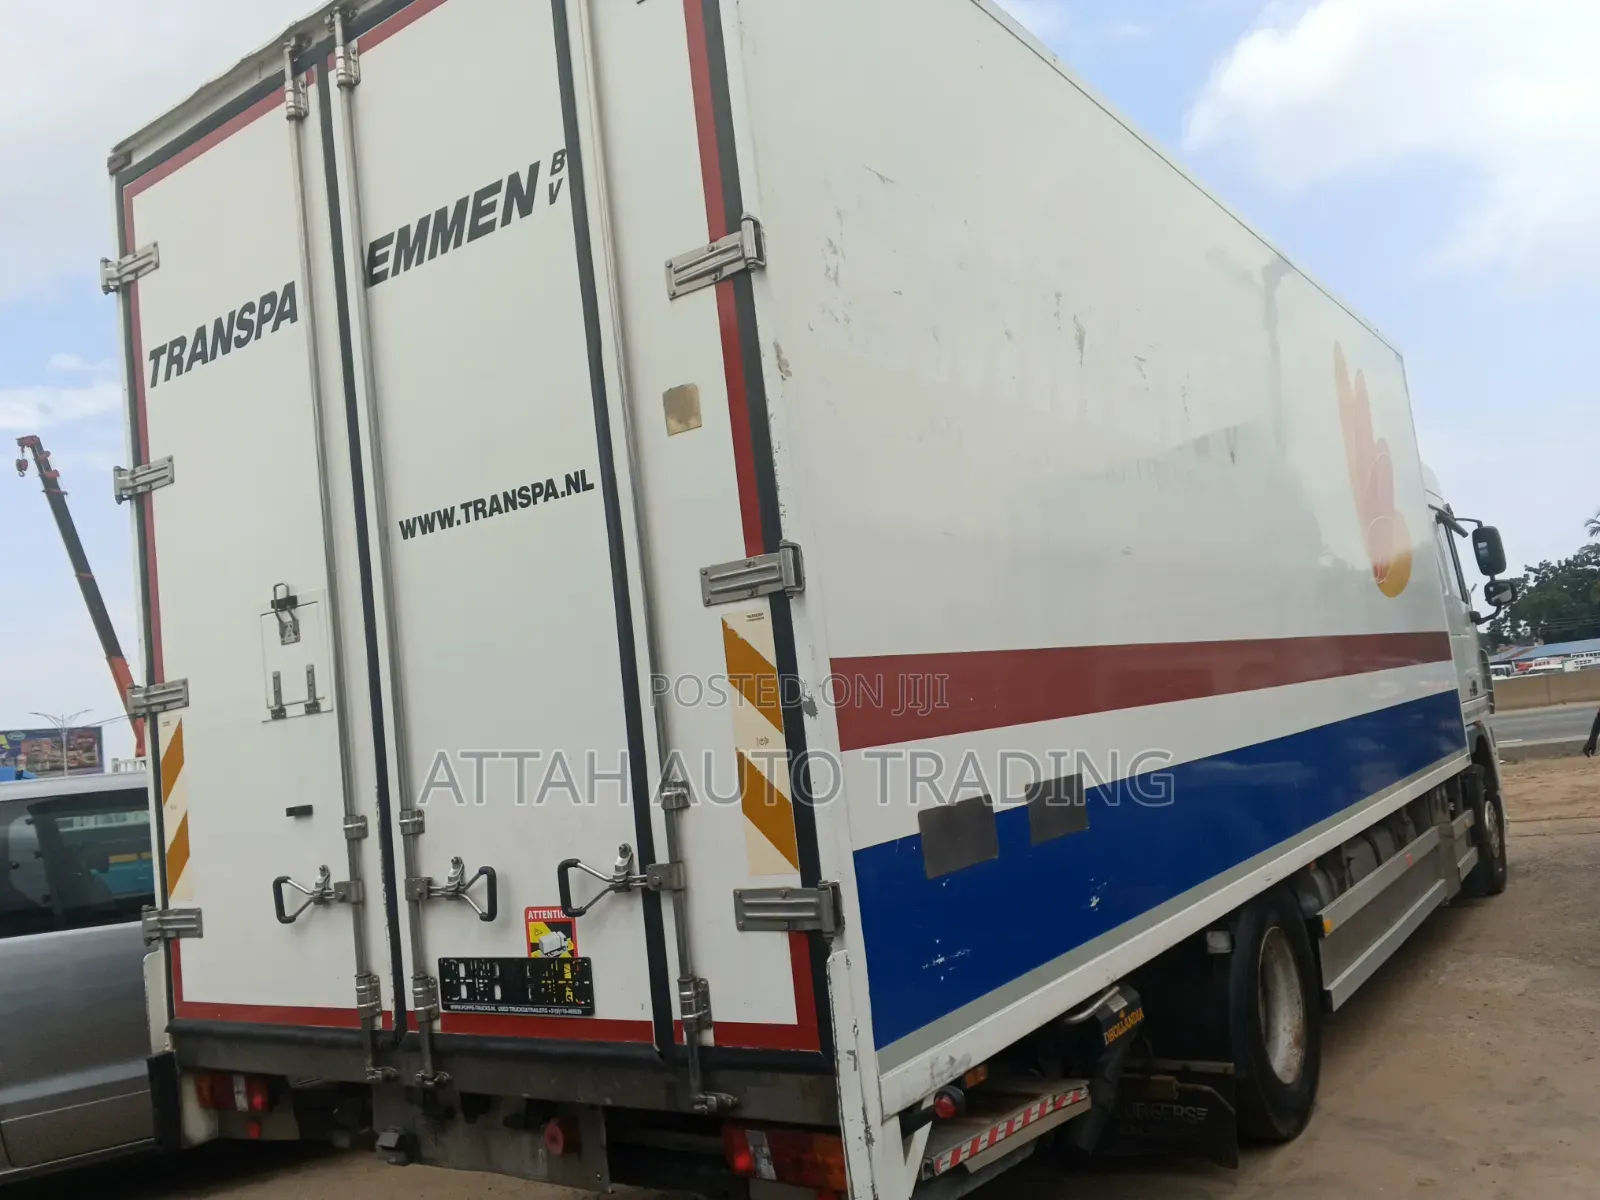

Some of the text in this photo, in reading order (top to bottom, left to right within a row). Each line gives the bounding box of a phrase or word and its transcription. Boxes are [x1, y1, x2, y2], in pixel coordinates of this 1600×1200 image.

[149, 160, 541, 388] TRANSPA EMMEN
[398, 469, 595, 541] WWW.TRANSPA.NL
[528, 909, 573, 919] ATTENTIO
